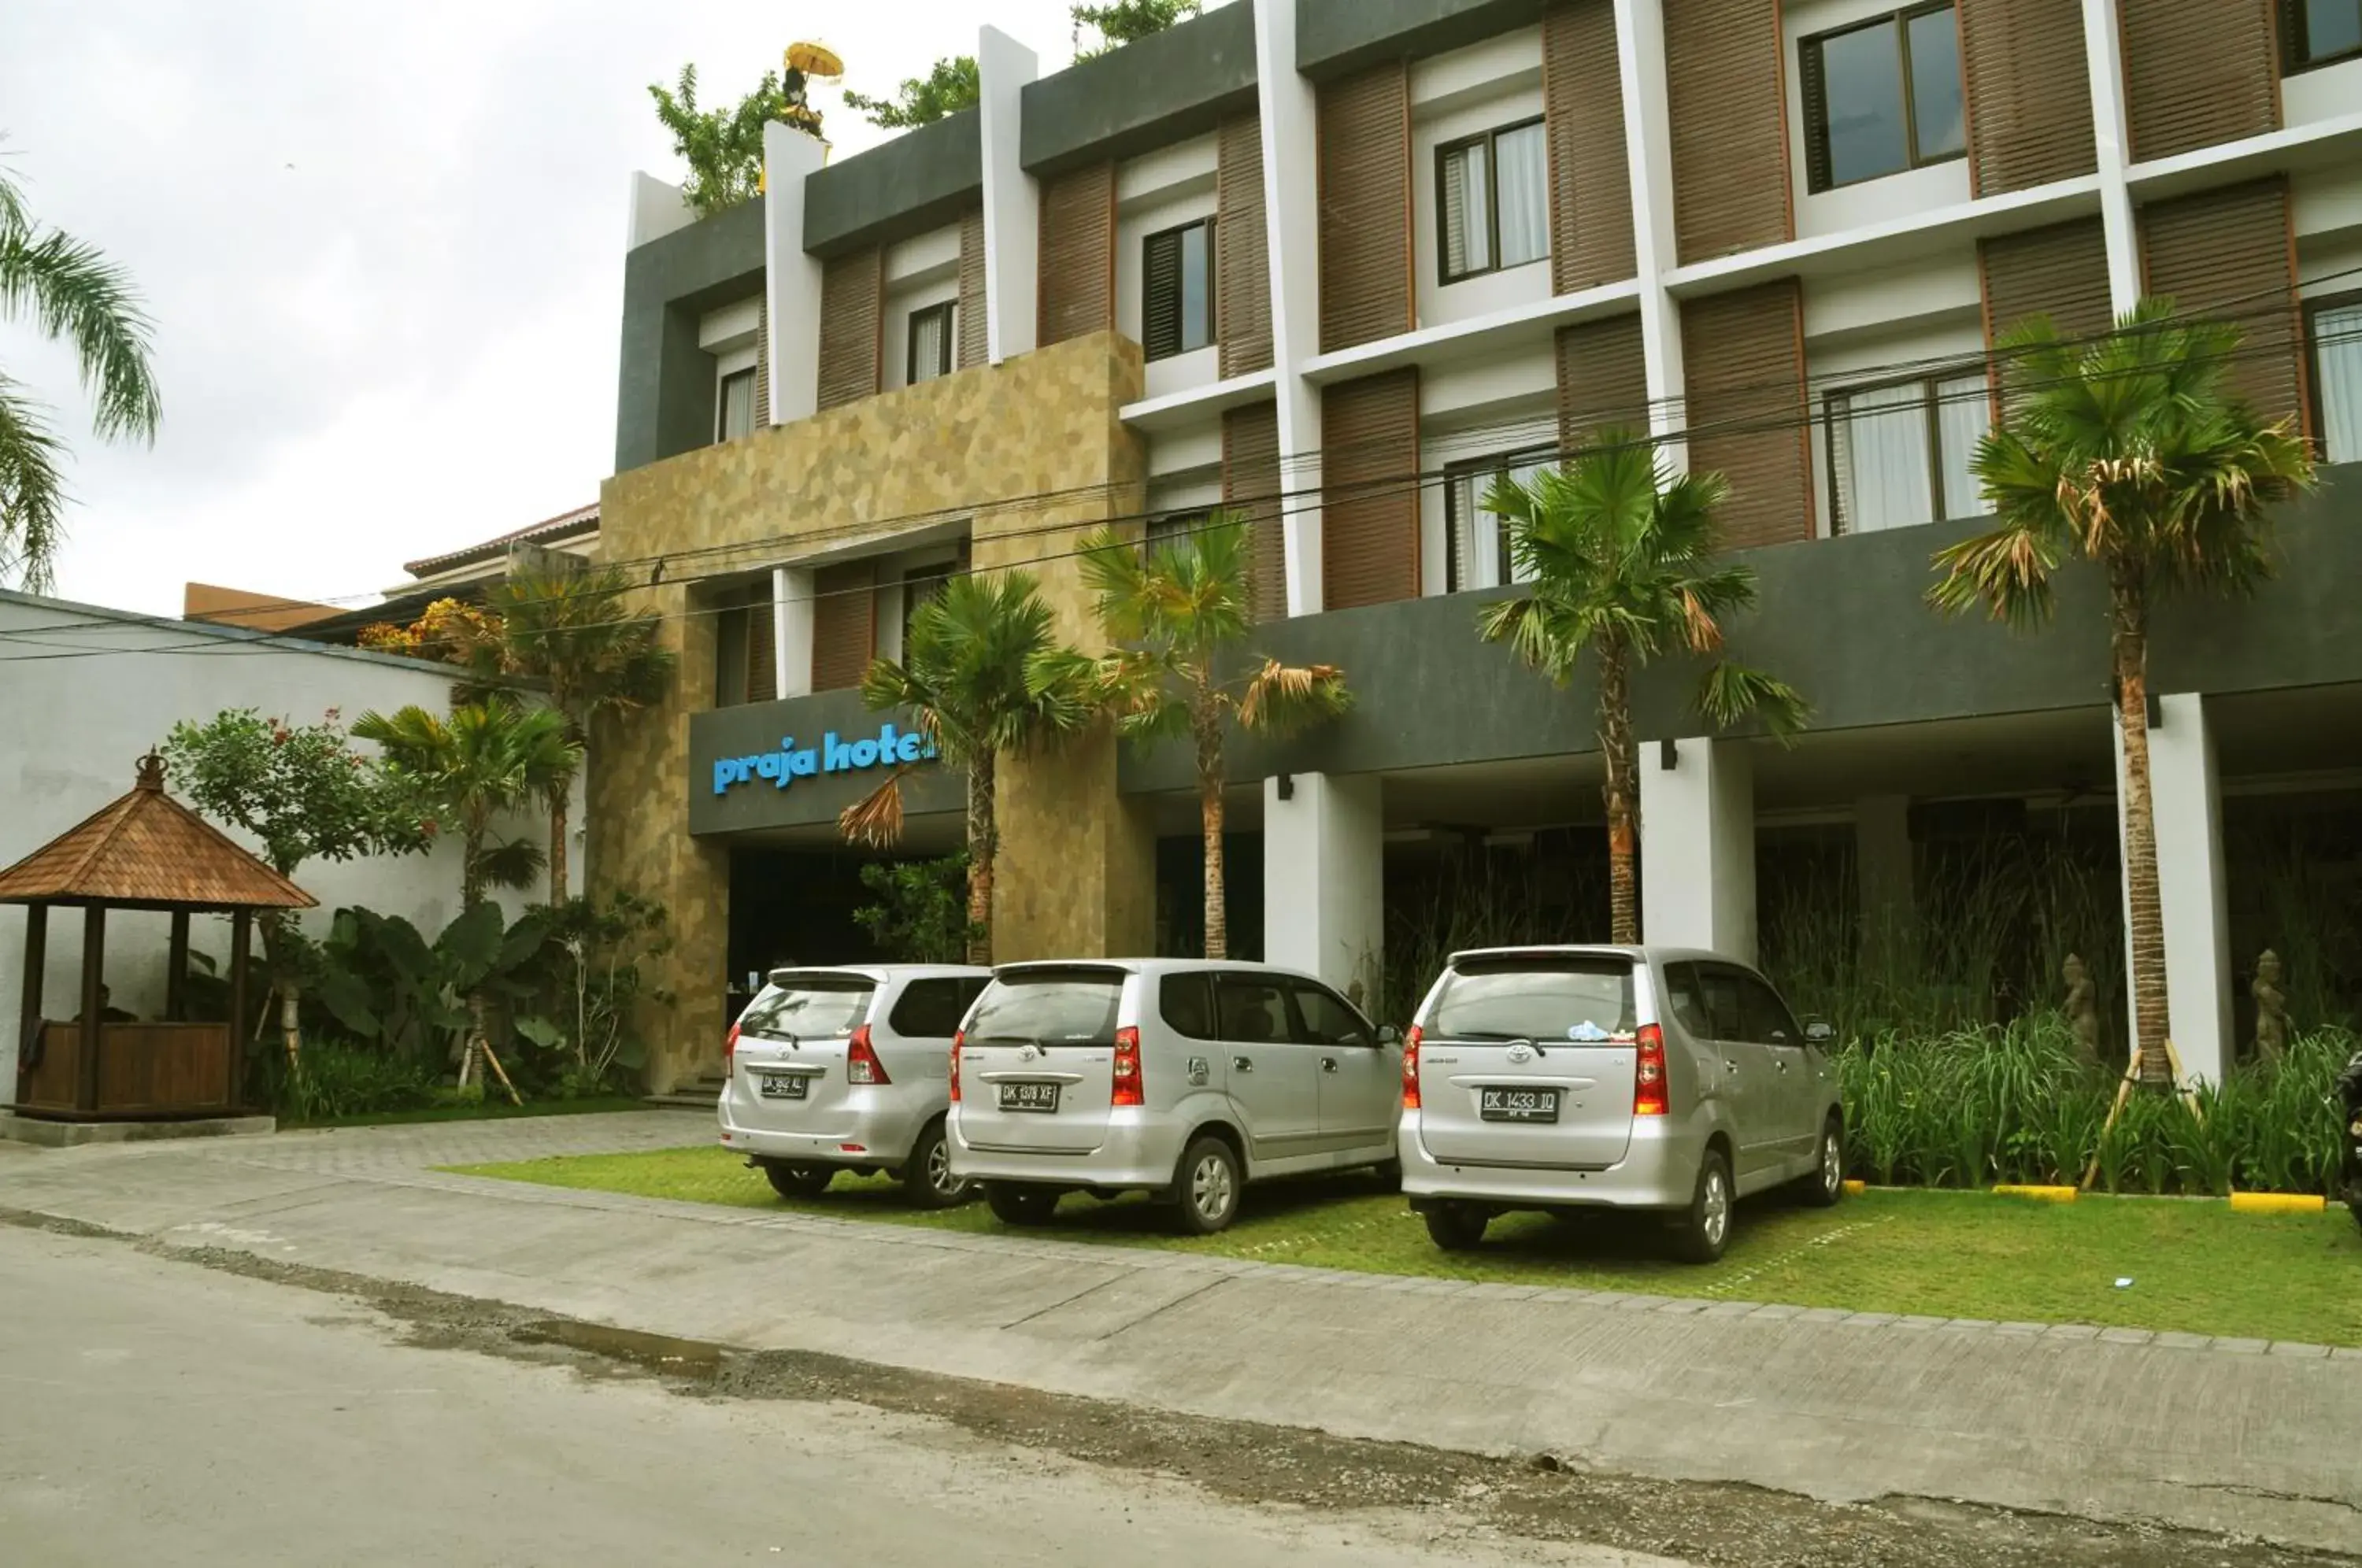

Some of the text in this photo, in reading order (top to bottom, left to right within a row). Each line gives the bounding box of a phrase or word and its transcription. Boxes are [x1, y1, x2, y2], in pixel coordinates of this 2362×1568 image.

[713, 736, 818, 794] praja
[1003, 1085, 1016, 1099] DK
[1484, 1091, 1501, 1108] DK
[1507, 1092, 1535, 1108] 1433
